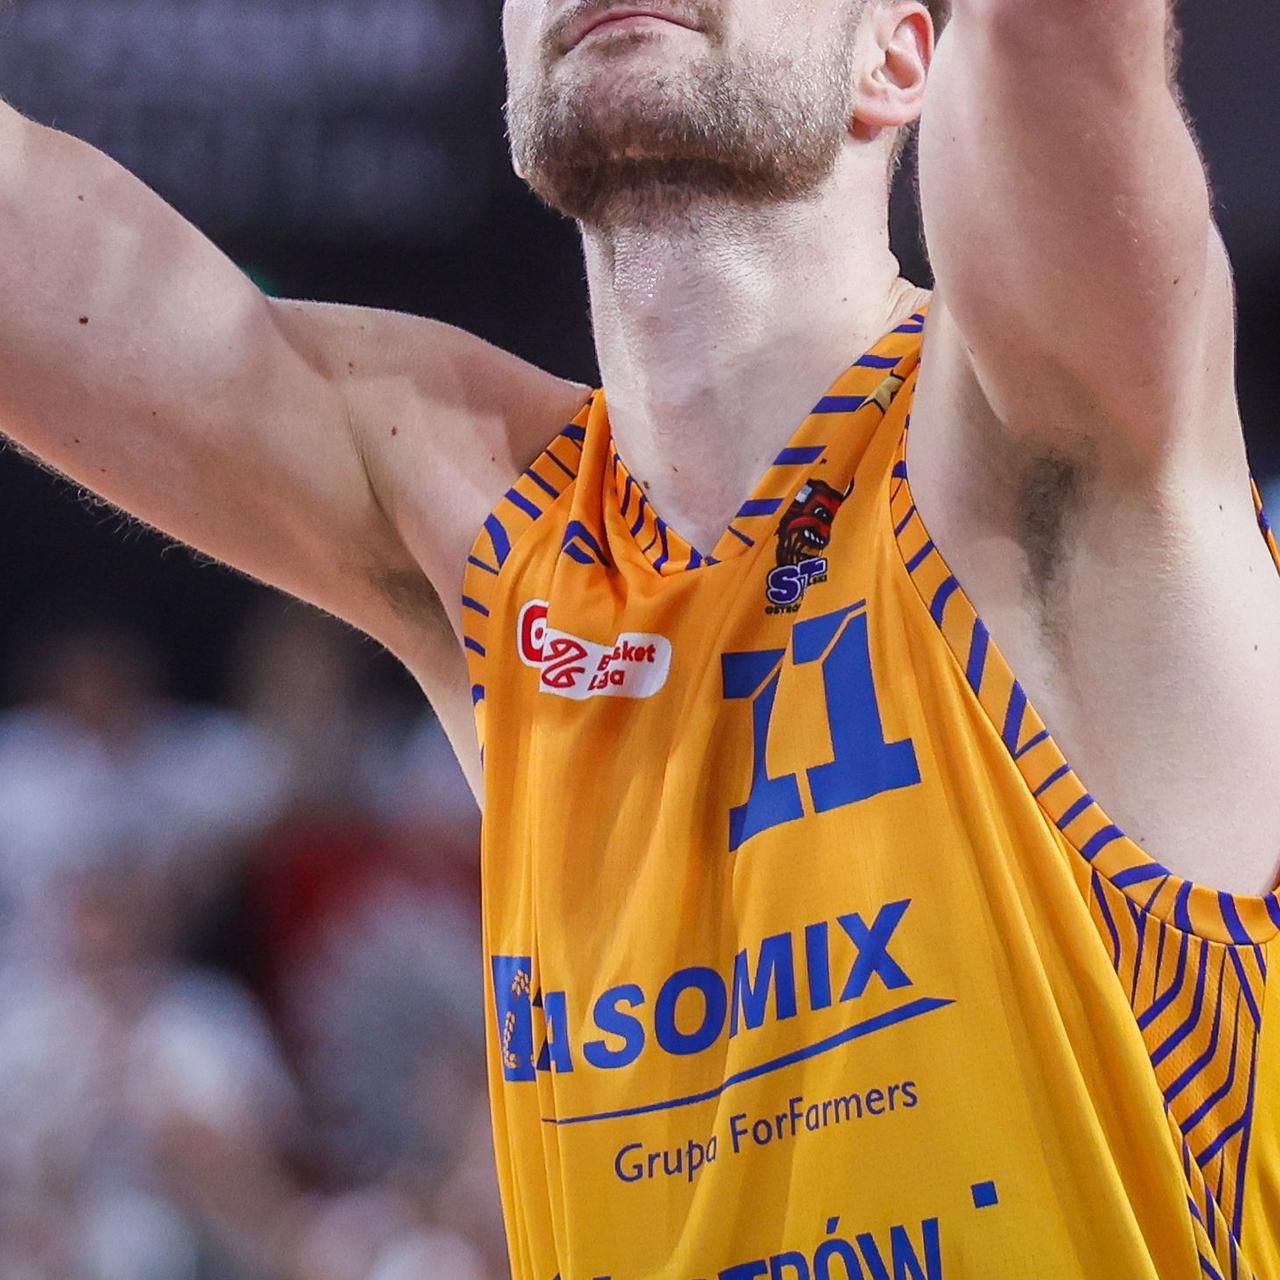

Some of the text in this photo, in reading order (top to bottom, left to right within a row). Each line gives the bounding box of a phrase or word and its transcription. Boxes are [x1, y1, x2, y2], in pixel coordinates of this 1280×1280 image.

[721, 599, 922, 852] 11
[615, 1080, 919, 1183] Grupa ForFarmers
